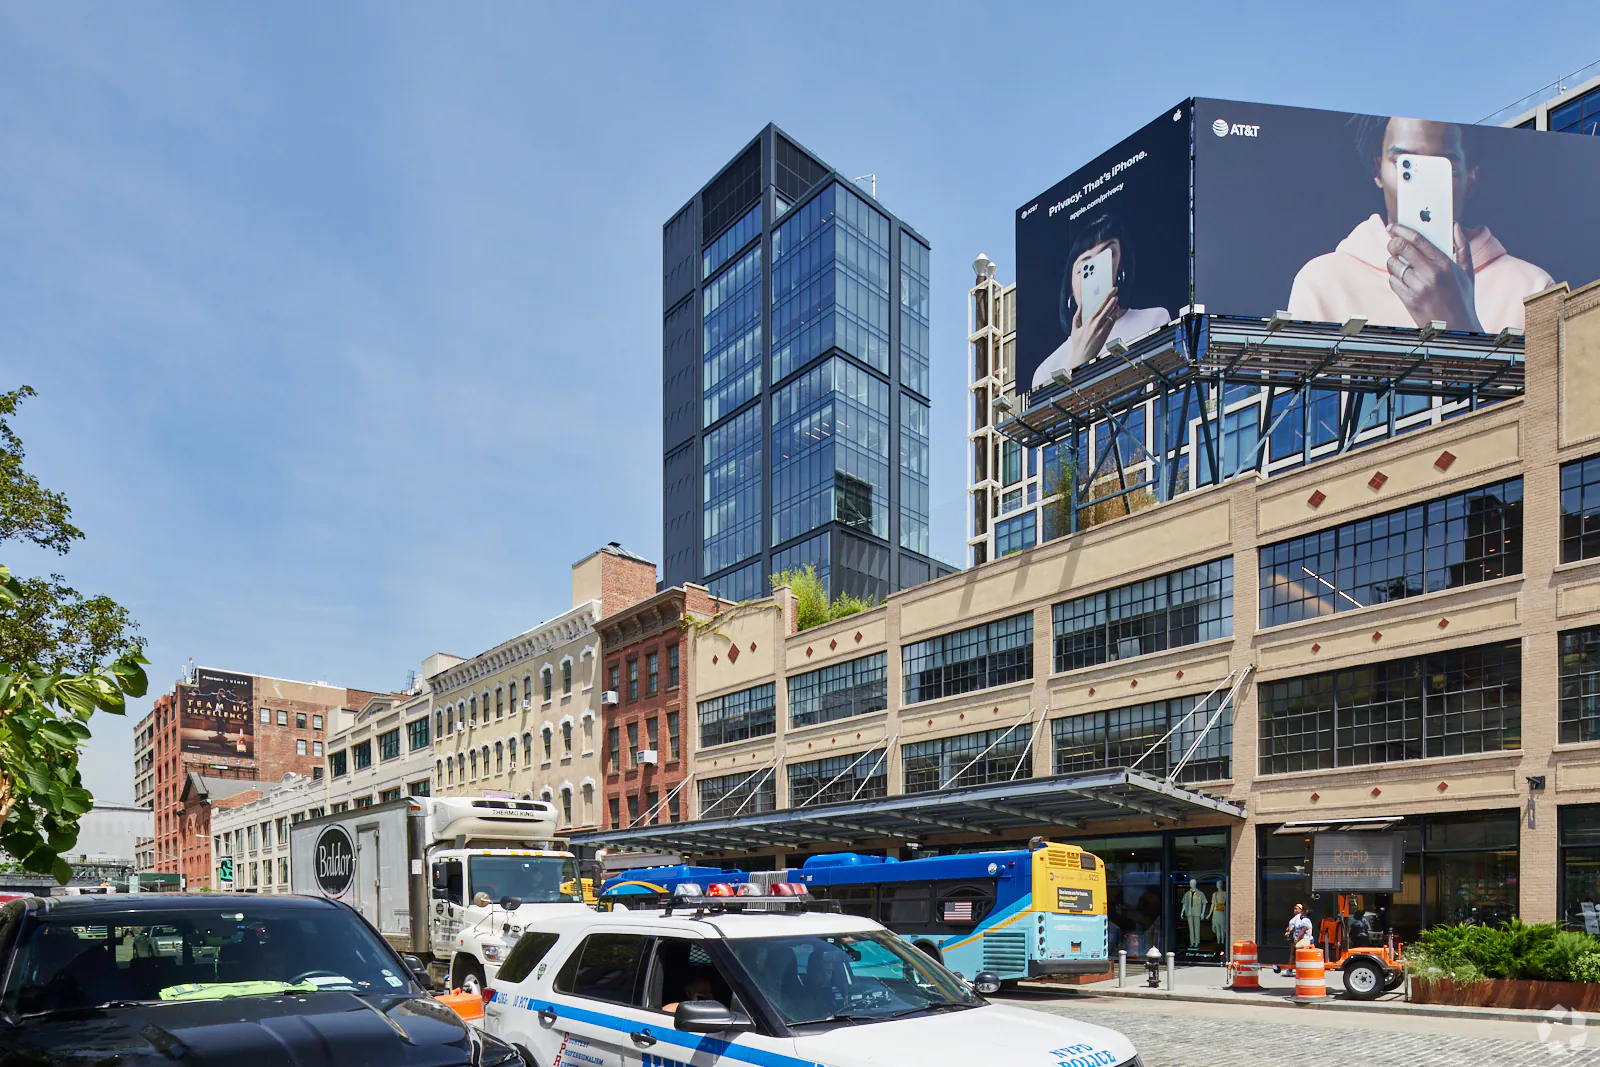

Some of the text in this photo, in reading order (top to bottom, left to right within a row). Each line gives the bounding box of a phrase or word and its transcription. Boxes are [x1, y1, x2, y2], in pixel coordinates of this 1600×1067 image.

[1230, 124, 1260, 137] AT&T
[1049, 150, 1147, 217] Privacy. That's iPhone.
[1069, 182, 1124, 221] apple.com/privacy
[1027, 204, 1038, 215] AT&T
[188, 700, 224, 710] TEAM
[187, 707, 248, 720] EXCELLENCE
[492, 809, 519, 817] THERMO
[319, 842, 351, 877] Baldor
[1333, 848, 1369, 864] ROAD
[1316, 867, 1389, 878] CONSTRUCTION
[564, 1032, 590, 1049] COURTESY
[559, 1043, 604, 1066] PROFESSIONALISM
[1049, 1043, 1093, 1058] NYPD
